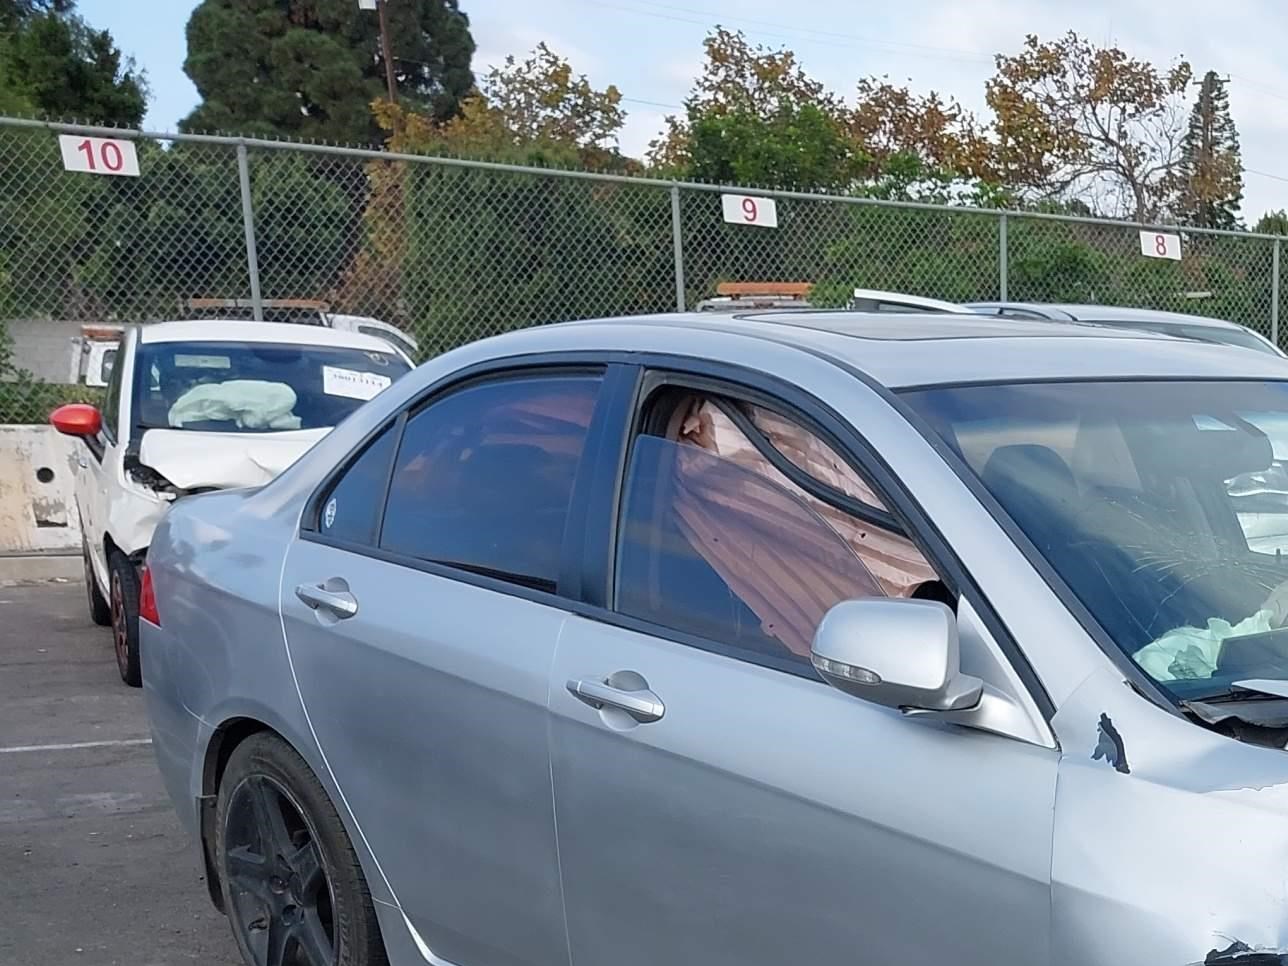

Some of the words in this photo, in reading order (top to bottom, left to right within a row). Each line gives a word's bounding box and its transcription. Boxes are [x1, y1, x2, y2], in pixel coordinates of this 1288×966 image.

[78, 139, 124, 171] 10
[742, 198, 757, 222] 9
[1155, 234, 1167, 256] 8
